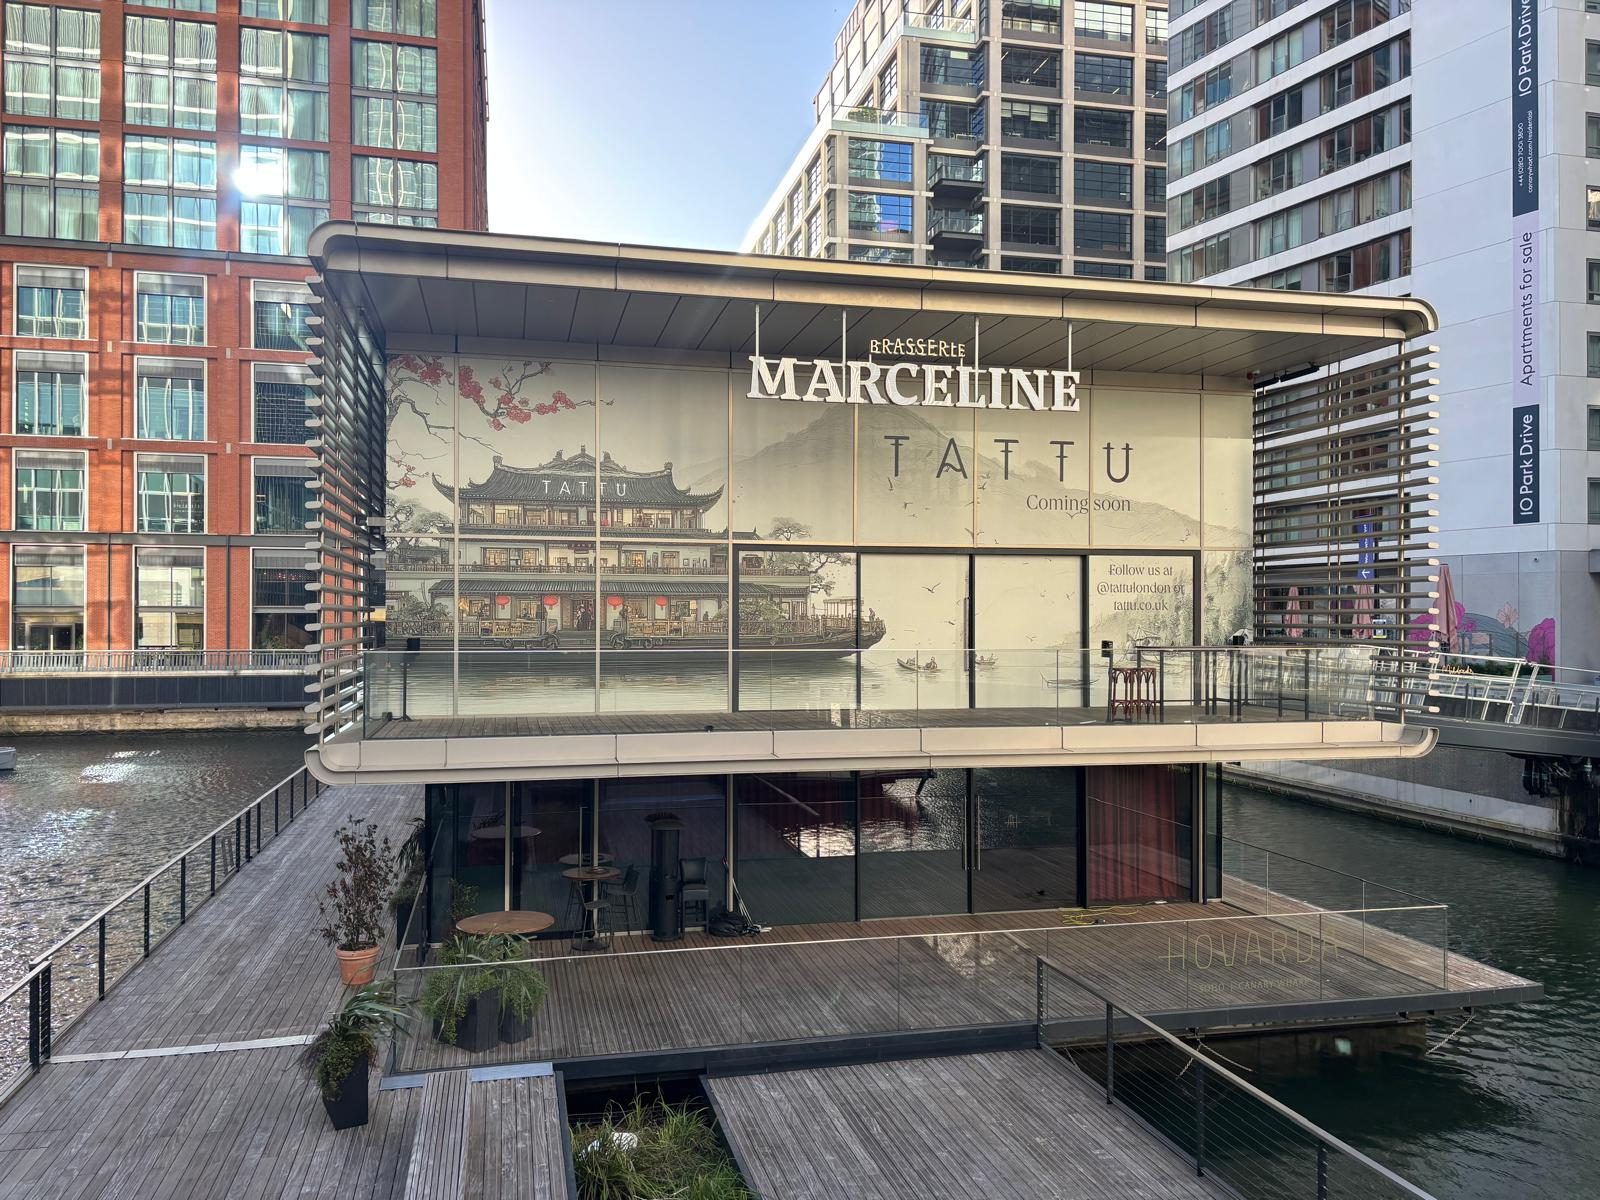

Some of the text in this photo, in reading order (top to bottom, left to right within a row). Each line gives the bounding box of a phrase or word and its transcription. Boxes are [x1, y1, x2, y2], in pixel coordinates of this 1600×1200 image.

[1518, 37, 1532, 76] Park
[1520, 232, 1535, 386] Apartments for sale
[870, 337, 966, 358] BRASSERIE
[746, 355, 1081, 412] MARCELINE
[1520, 414, 1533, 456] Drive
[884, 435, 1134, 484] TATTU
[1520, 458, 1533, 494] Park
[542, 480, 626, 497] TATTU
[1026, 494, 1131, 514] Coming soon
[1097, 581, 1171, 595] @tattulondon
[1109, 564, 1173, 576] Follow us at
[1113, 600, 1168, 611] tattu.co.uk
[1158, 929, 1338, 972] HOVARDA
